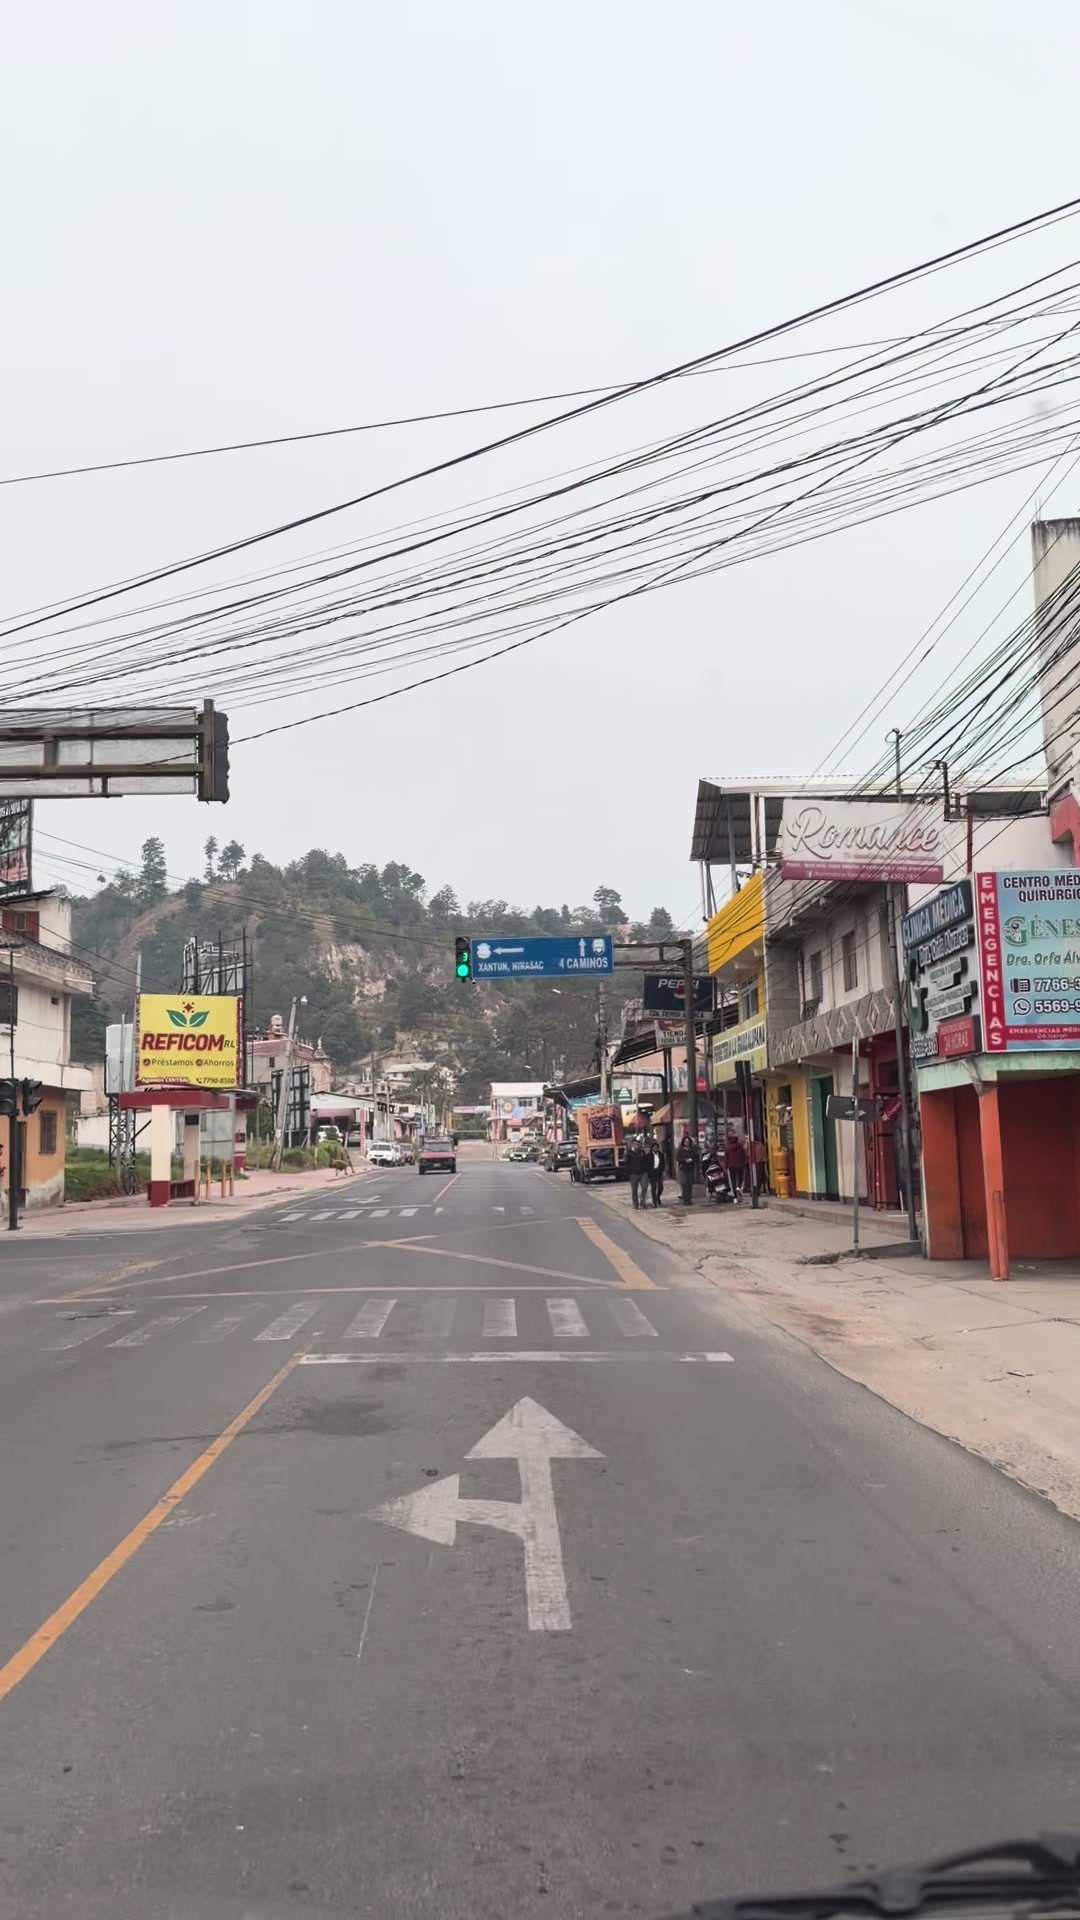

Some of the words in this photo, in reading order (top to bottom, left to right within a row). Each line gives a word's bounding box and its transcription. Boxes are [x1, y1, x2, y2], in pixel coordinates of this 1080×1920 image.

[786, 807, 940, 860] Romance
[1003, 876, 1050, 889] CENTRO
[559, 958, 566, 969] 4
[567, 957, 609, 969] CAMINOS
[981, 876, 1004, 1046] EMERGENCIAS
[1006, 953, 1031, 966] Dra.
[1034, 952, 1061, 965] Orfa
[478, 961, 510, 972] XANTUN,
[657, 979, 700, 989] PEPI
[141, 1033, 225, 1052] REFICOM
[224, 1040, 235, 1048] RL
[151, 1058, 194, 1067] Préstamos
[203, 1059, 235, 1067] Ahorros
